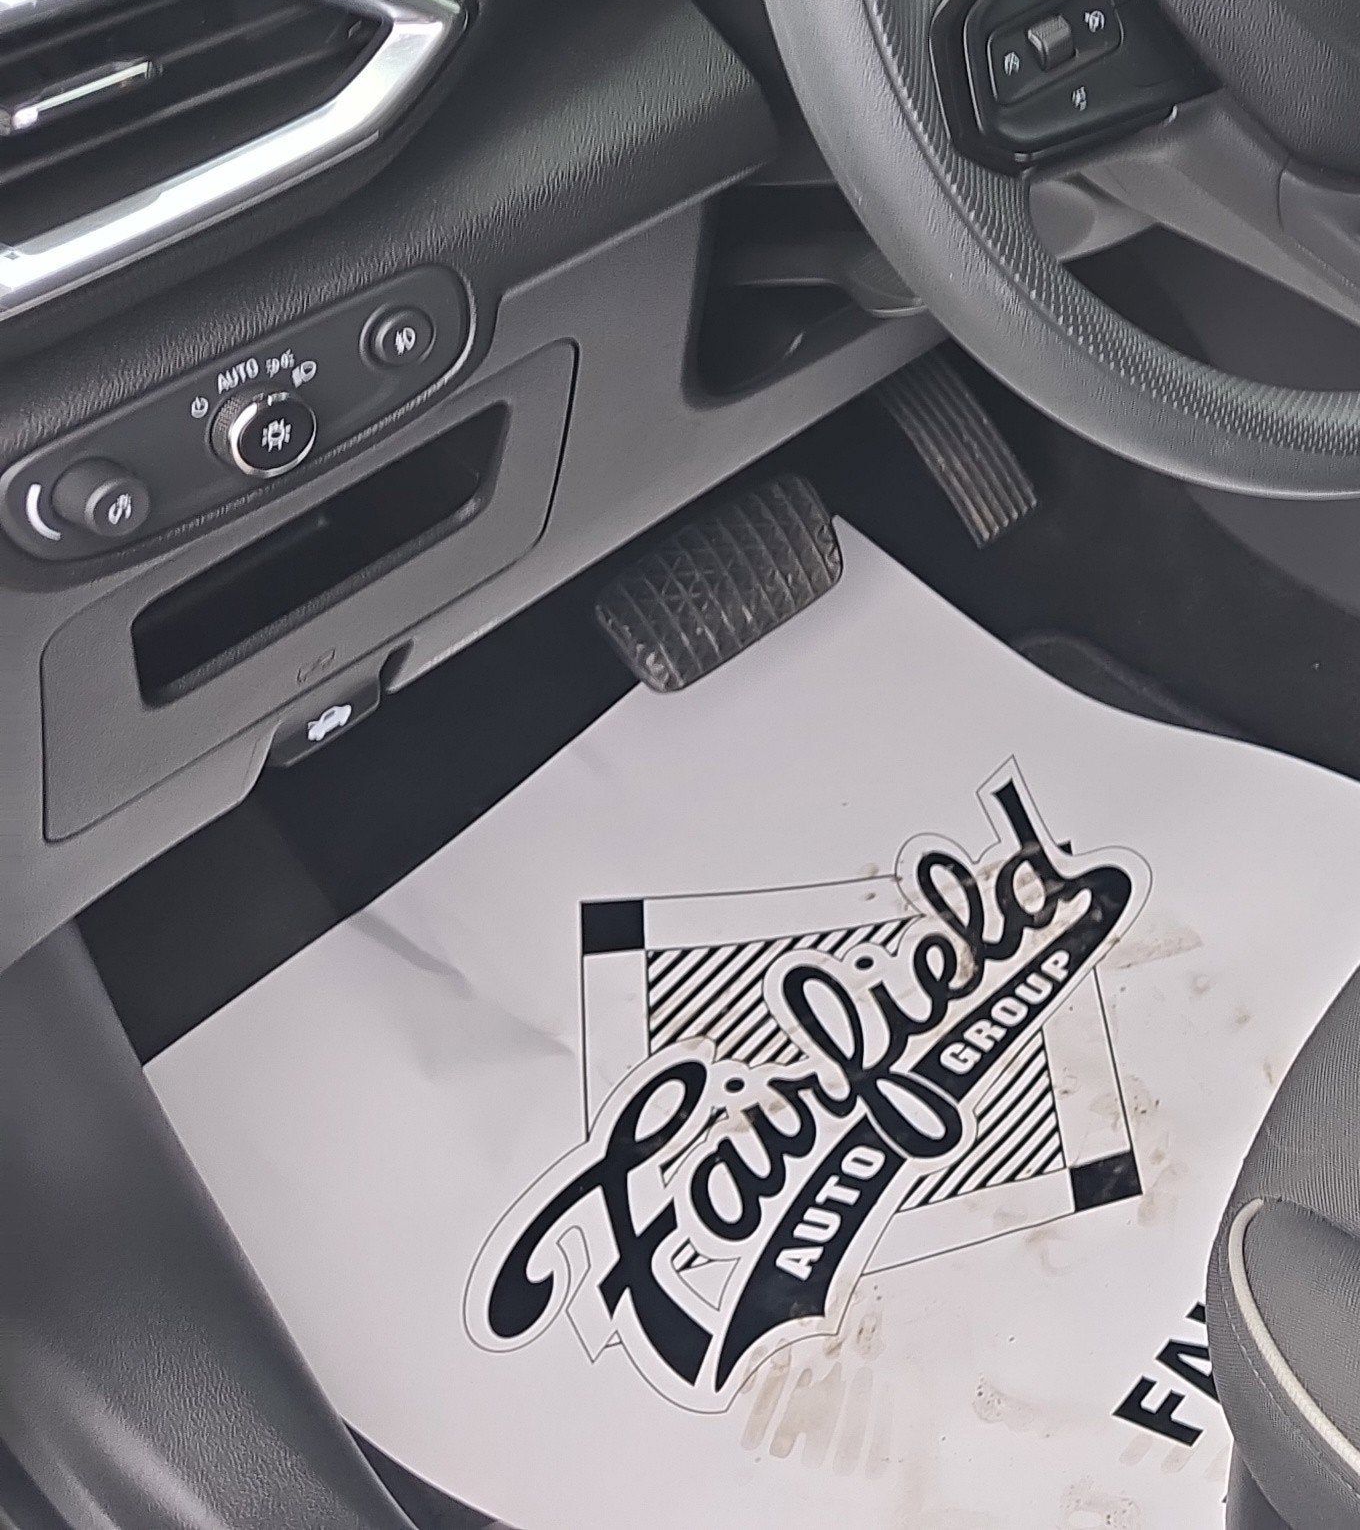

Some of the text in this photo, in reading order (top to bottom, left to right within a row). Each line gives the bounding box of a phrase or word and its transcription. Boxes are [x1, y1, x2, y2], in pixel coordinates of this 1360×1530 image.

[217, 357, 259, 395] AUTO
[486, 779, 1133, 1388] Fairfield
[774, 949, 1075, 1281] AUTO GROUP
